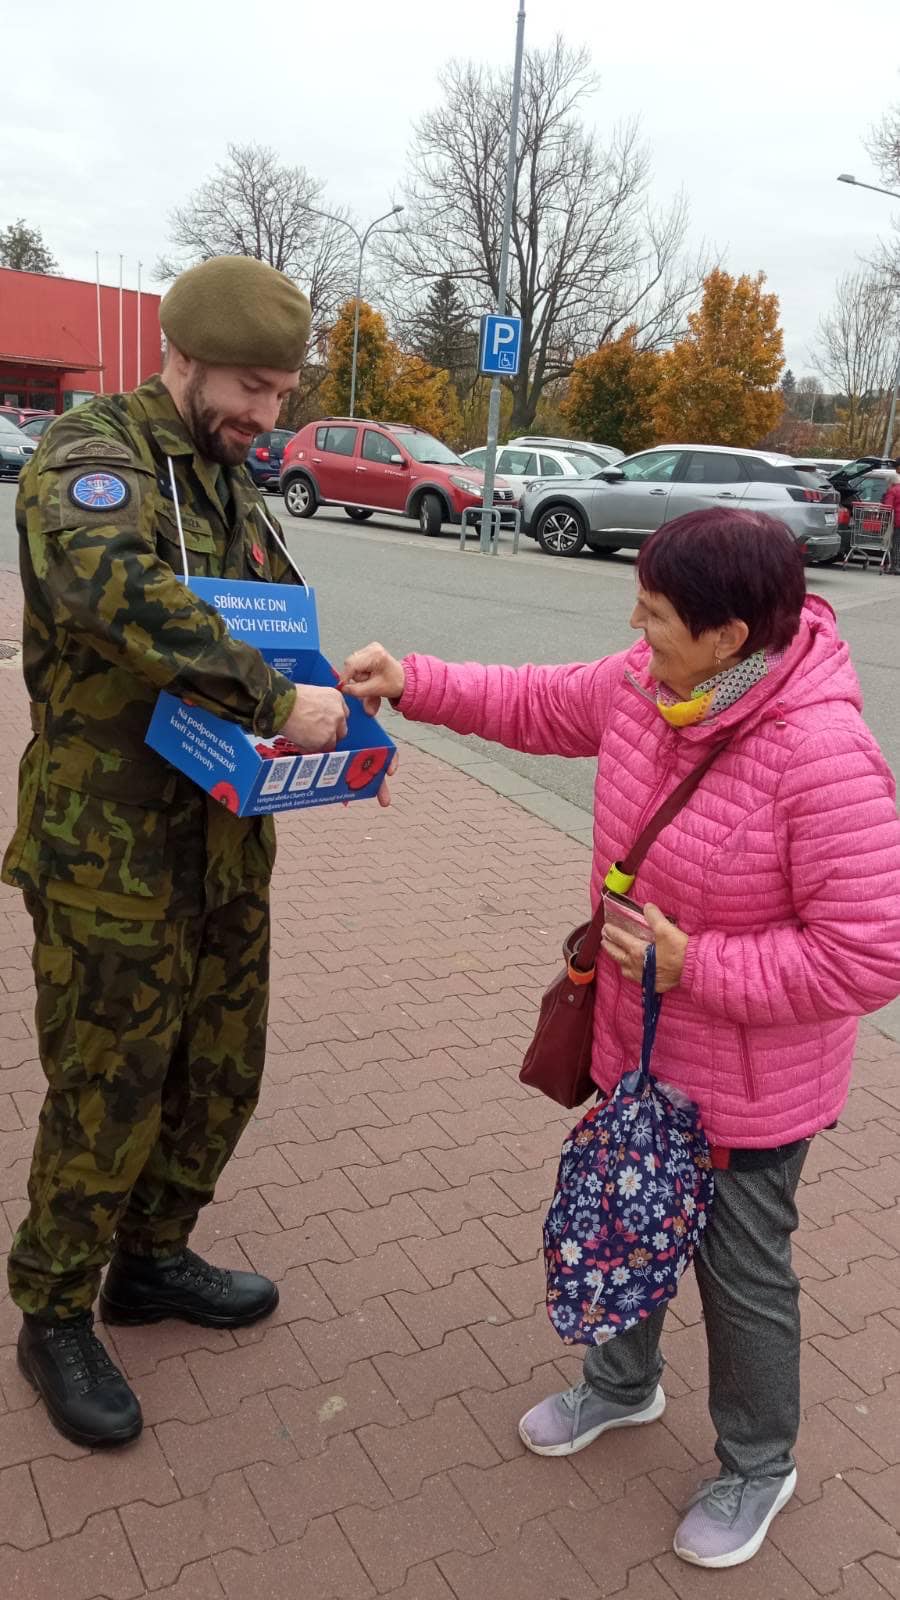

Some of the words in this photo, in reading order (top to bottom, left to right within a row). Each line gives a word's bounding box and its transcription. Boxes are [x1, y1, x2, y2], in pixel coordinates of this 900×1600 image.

[493, 323, 514, 355] P
[214, 593, 252, 610] SBÍRKA
[254, 598, 266, 611] KE
[269, 599, 286, 612] DNI
[257, 617, 308, 633] VETERÁNŮ
[170, 715, 188, 734] kteří
[186, 730, 196, 741] za
[195, 737, 207, 750] nás
[207, 746, 236, 773] nasazují
[178, 707, 188, 721] Na
[187, 716, 219, 743] podporu
[218, 738, 236, 758] těch,
[181, 741, 194, 753] své
[193, 749, 215, 771] životy.
